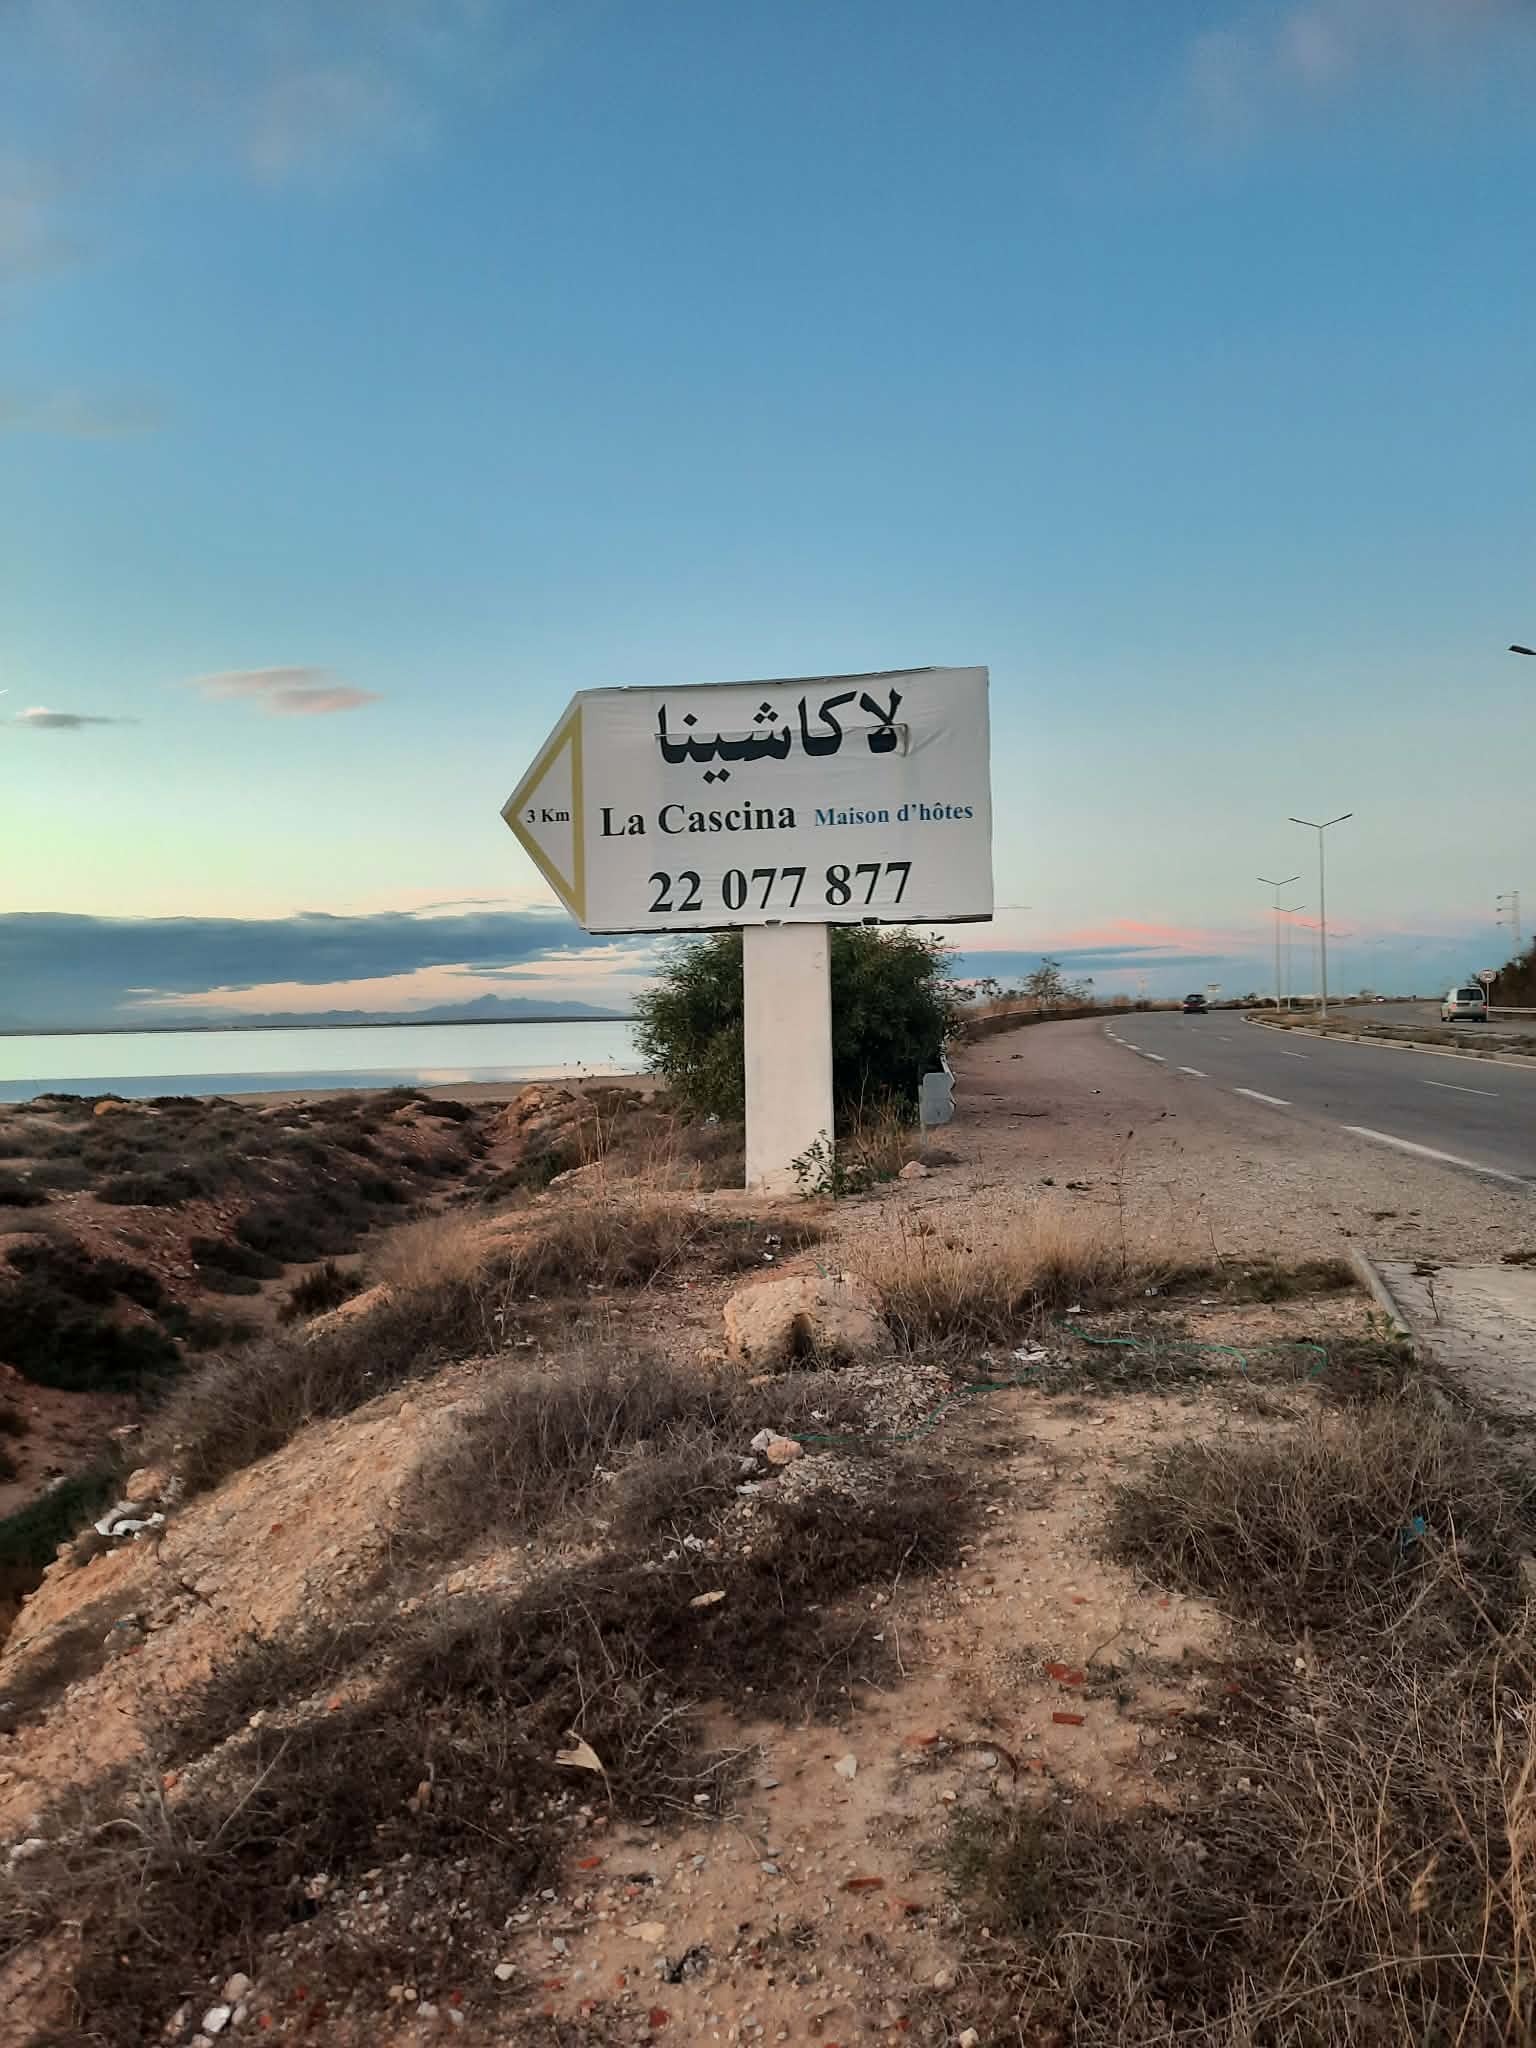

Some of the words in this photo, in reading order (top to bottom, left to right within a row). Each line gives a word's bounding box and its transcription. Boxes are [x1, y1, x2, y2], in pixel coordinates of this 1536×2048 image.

[527, 809, 536, 823] 3
[541, 808, 571, 824] Km
[600, 808, 646, 837] La
[658, 801, 797, 835] Cascina
[815, 806, 890, 827] Maison
[648, 871, 702, 913] 22
[721, 867, 807, 911] 077
[825, 862, 913, 906] 877
